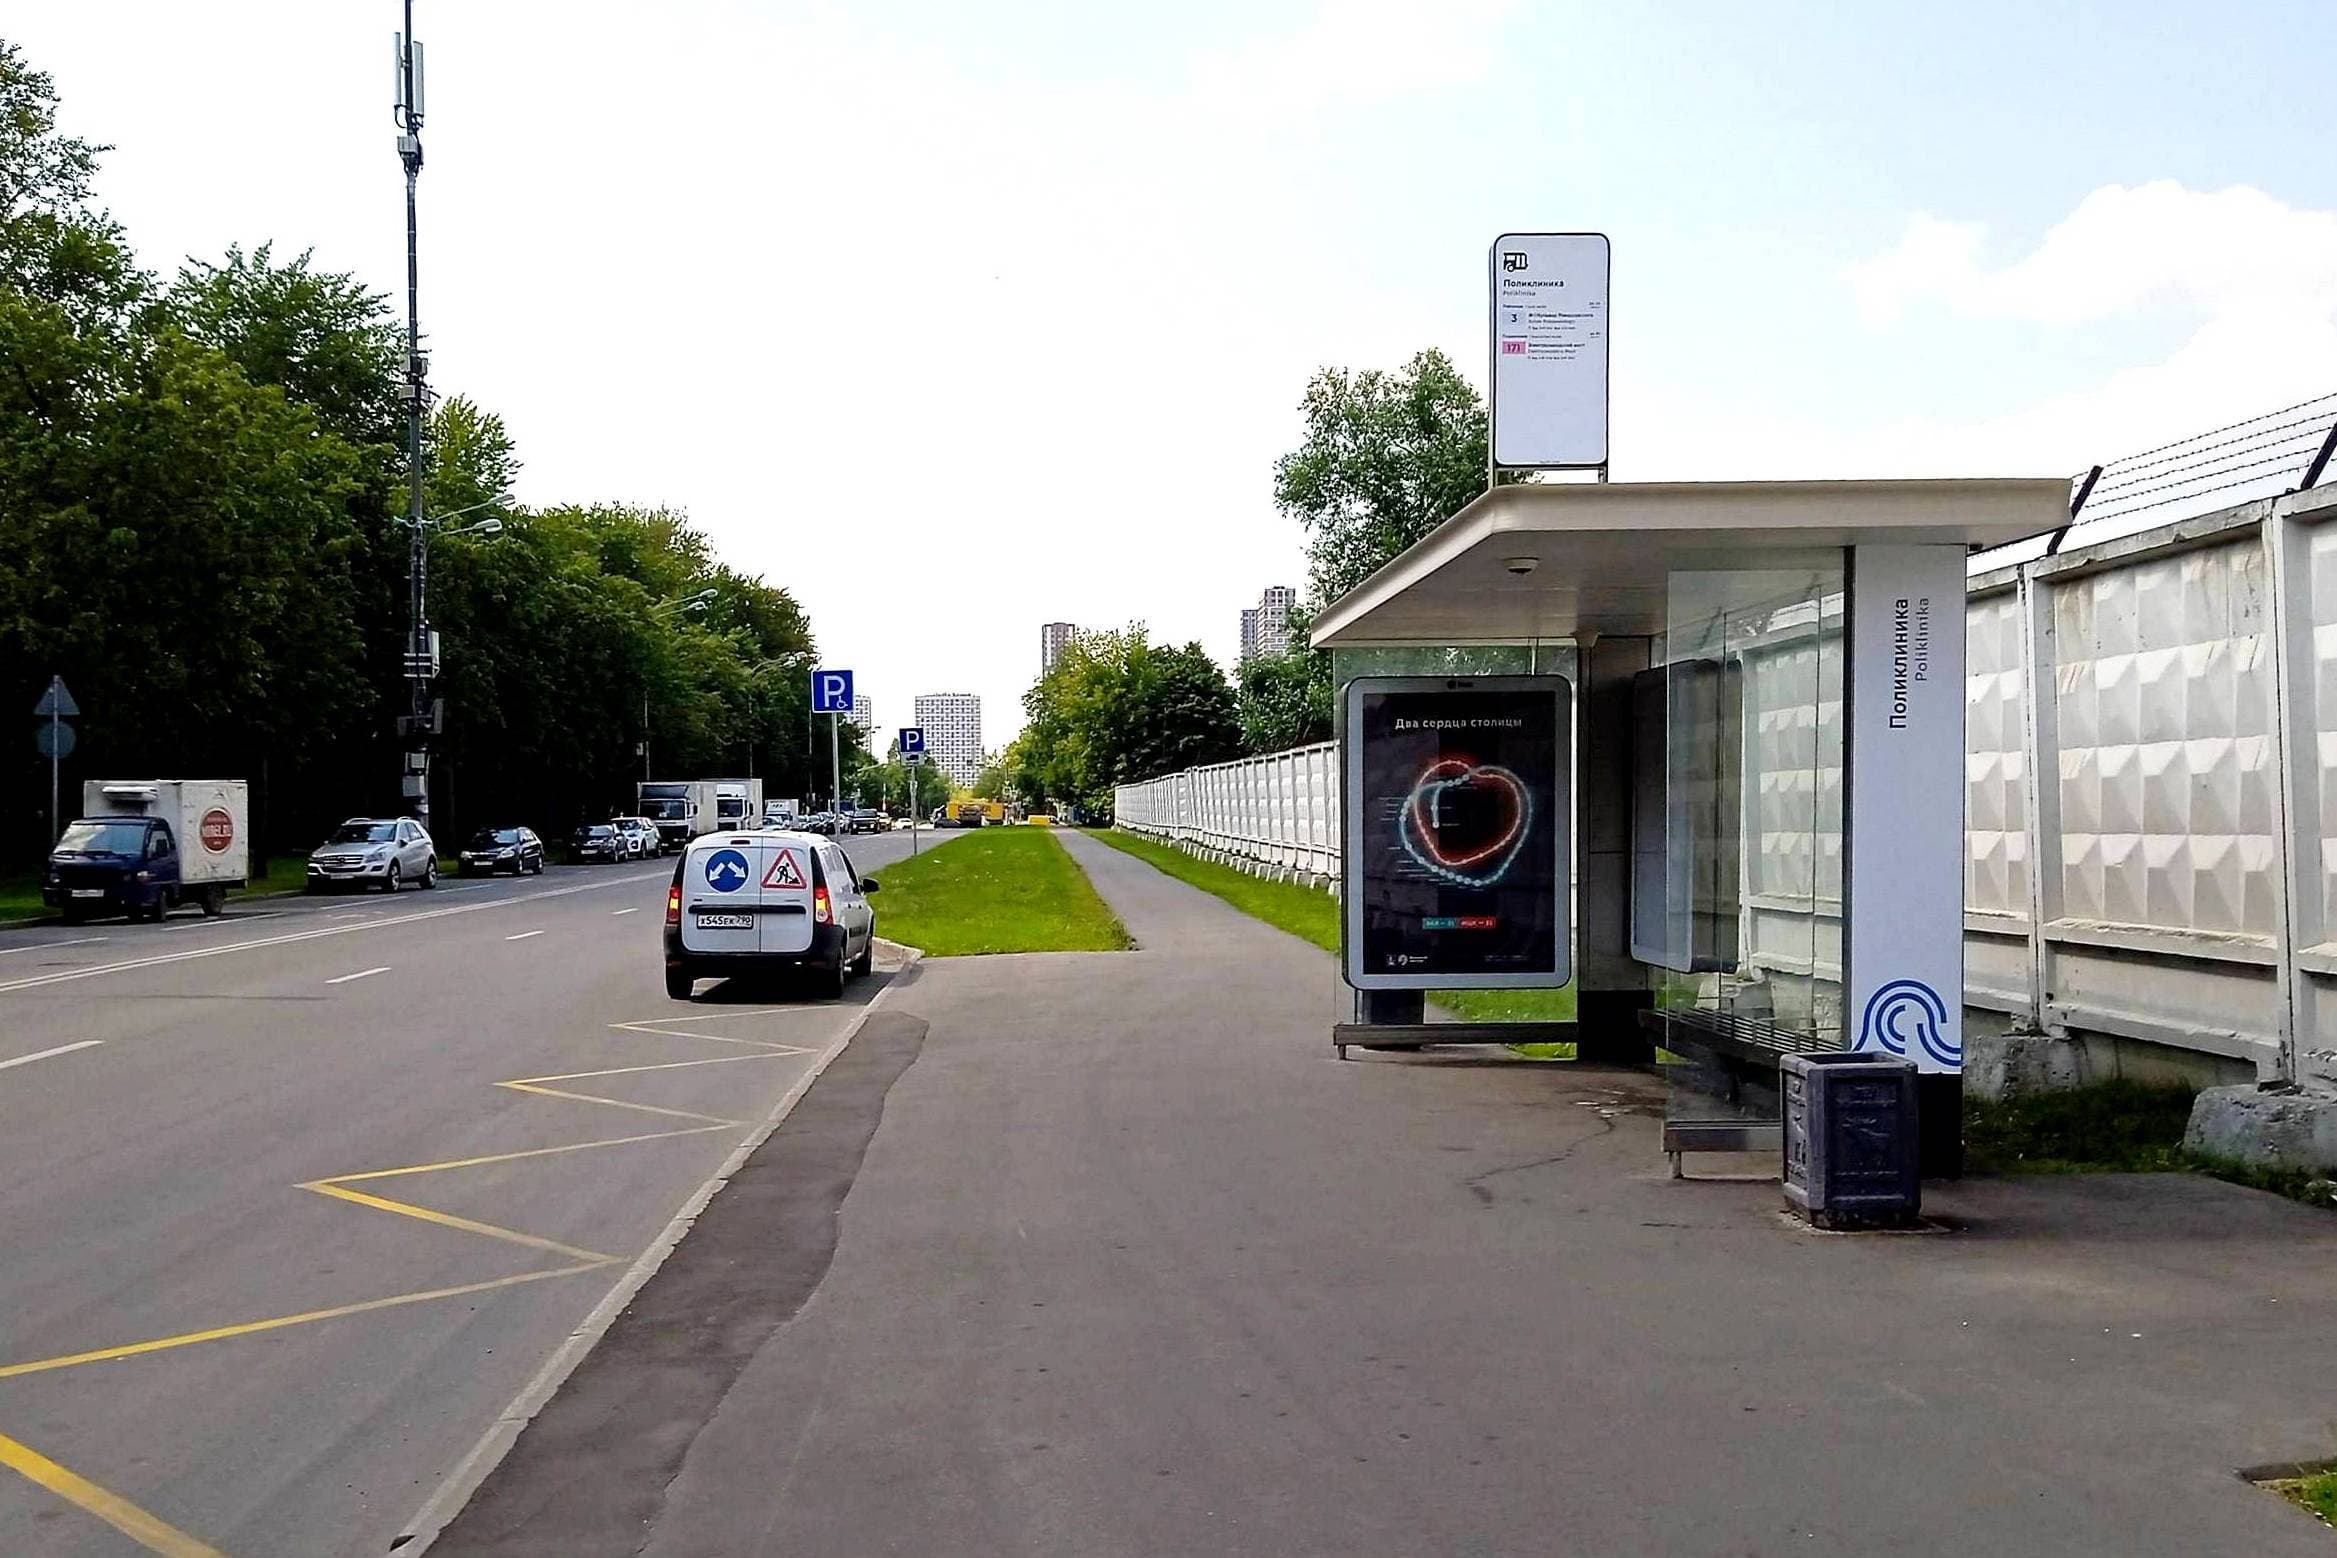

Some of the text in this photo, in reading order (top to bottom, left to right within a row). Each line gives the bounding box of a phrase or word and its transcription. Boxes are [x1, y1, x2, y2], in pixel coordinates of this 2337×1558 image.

[1503, 279, 1564, 287] Поликлиника
[1511, 313, 1518, 323] 3
[1914, 597, 1930, 682] Poliklinika
[1889, 598, 1909, 729] Поликлиника
[823, 675, 846, 708] P
[1394, 718, 1522, 730] Два сердца столицы
[905, 730, 920, 751] P
